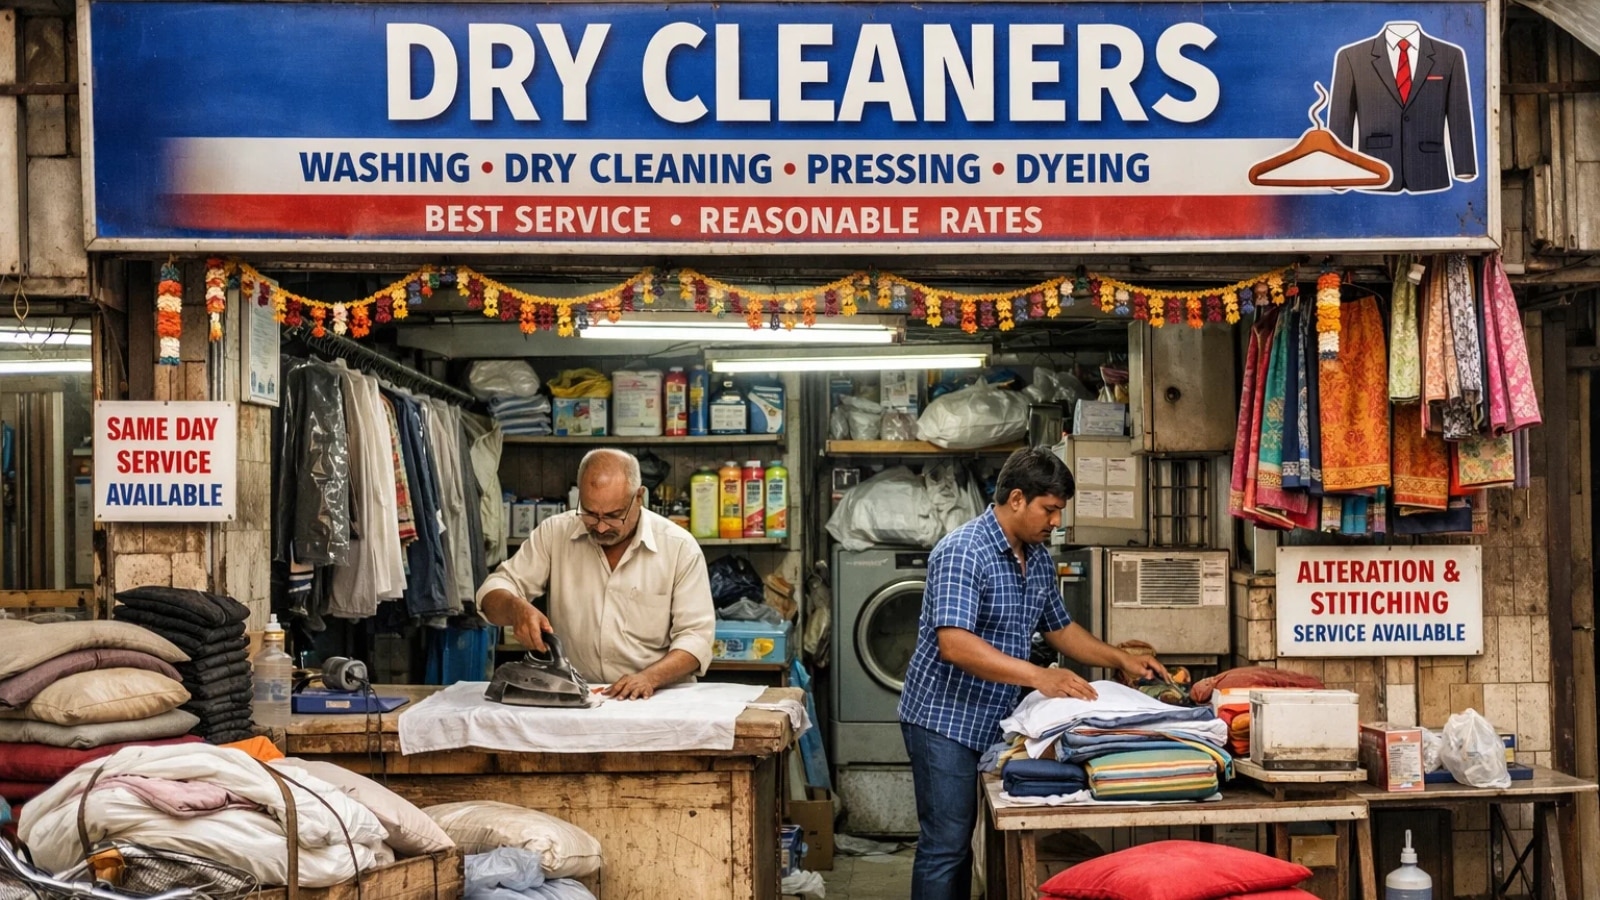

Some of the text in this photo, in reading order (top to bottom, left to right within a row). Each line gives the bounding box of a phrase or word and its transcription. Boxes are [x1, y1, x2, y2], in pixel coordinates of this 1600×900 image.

[386, 21, 1220, 123] DRY CLEANERS
[299, 152, 1150, 185] WASHING DRY CLEANING PRESSING DYEING
[425, 205, 1043, 235] BEST SERVICE REASONABLE RATES
[107, 416, 218, 441] SAME DAY
[117, 450, 211, 474] SERVICE
[106, 482, 223, 507] AVAILABLE
[1296, 559, 1461, 583] ALTERATION &
[1310, 590, 1449, 615] STITICHING
[1293, 623, 1465, 642] SERVICE AVAILABLE
